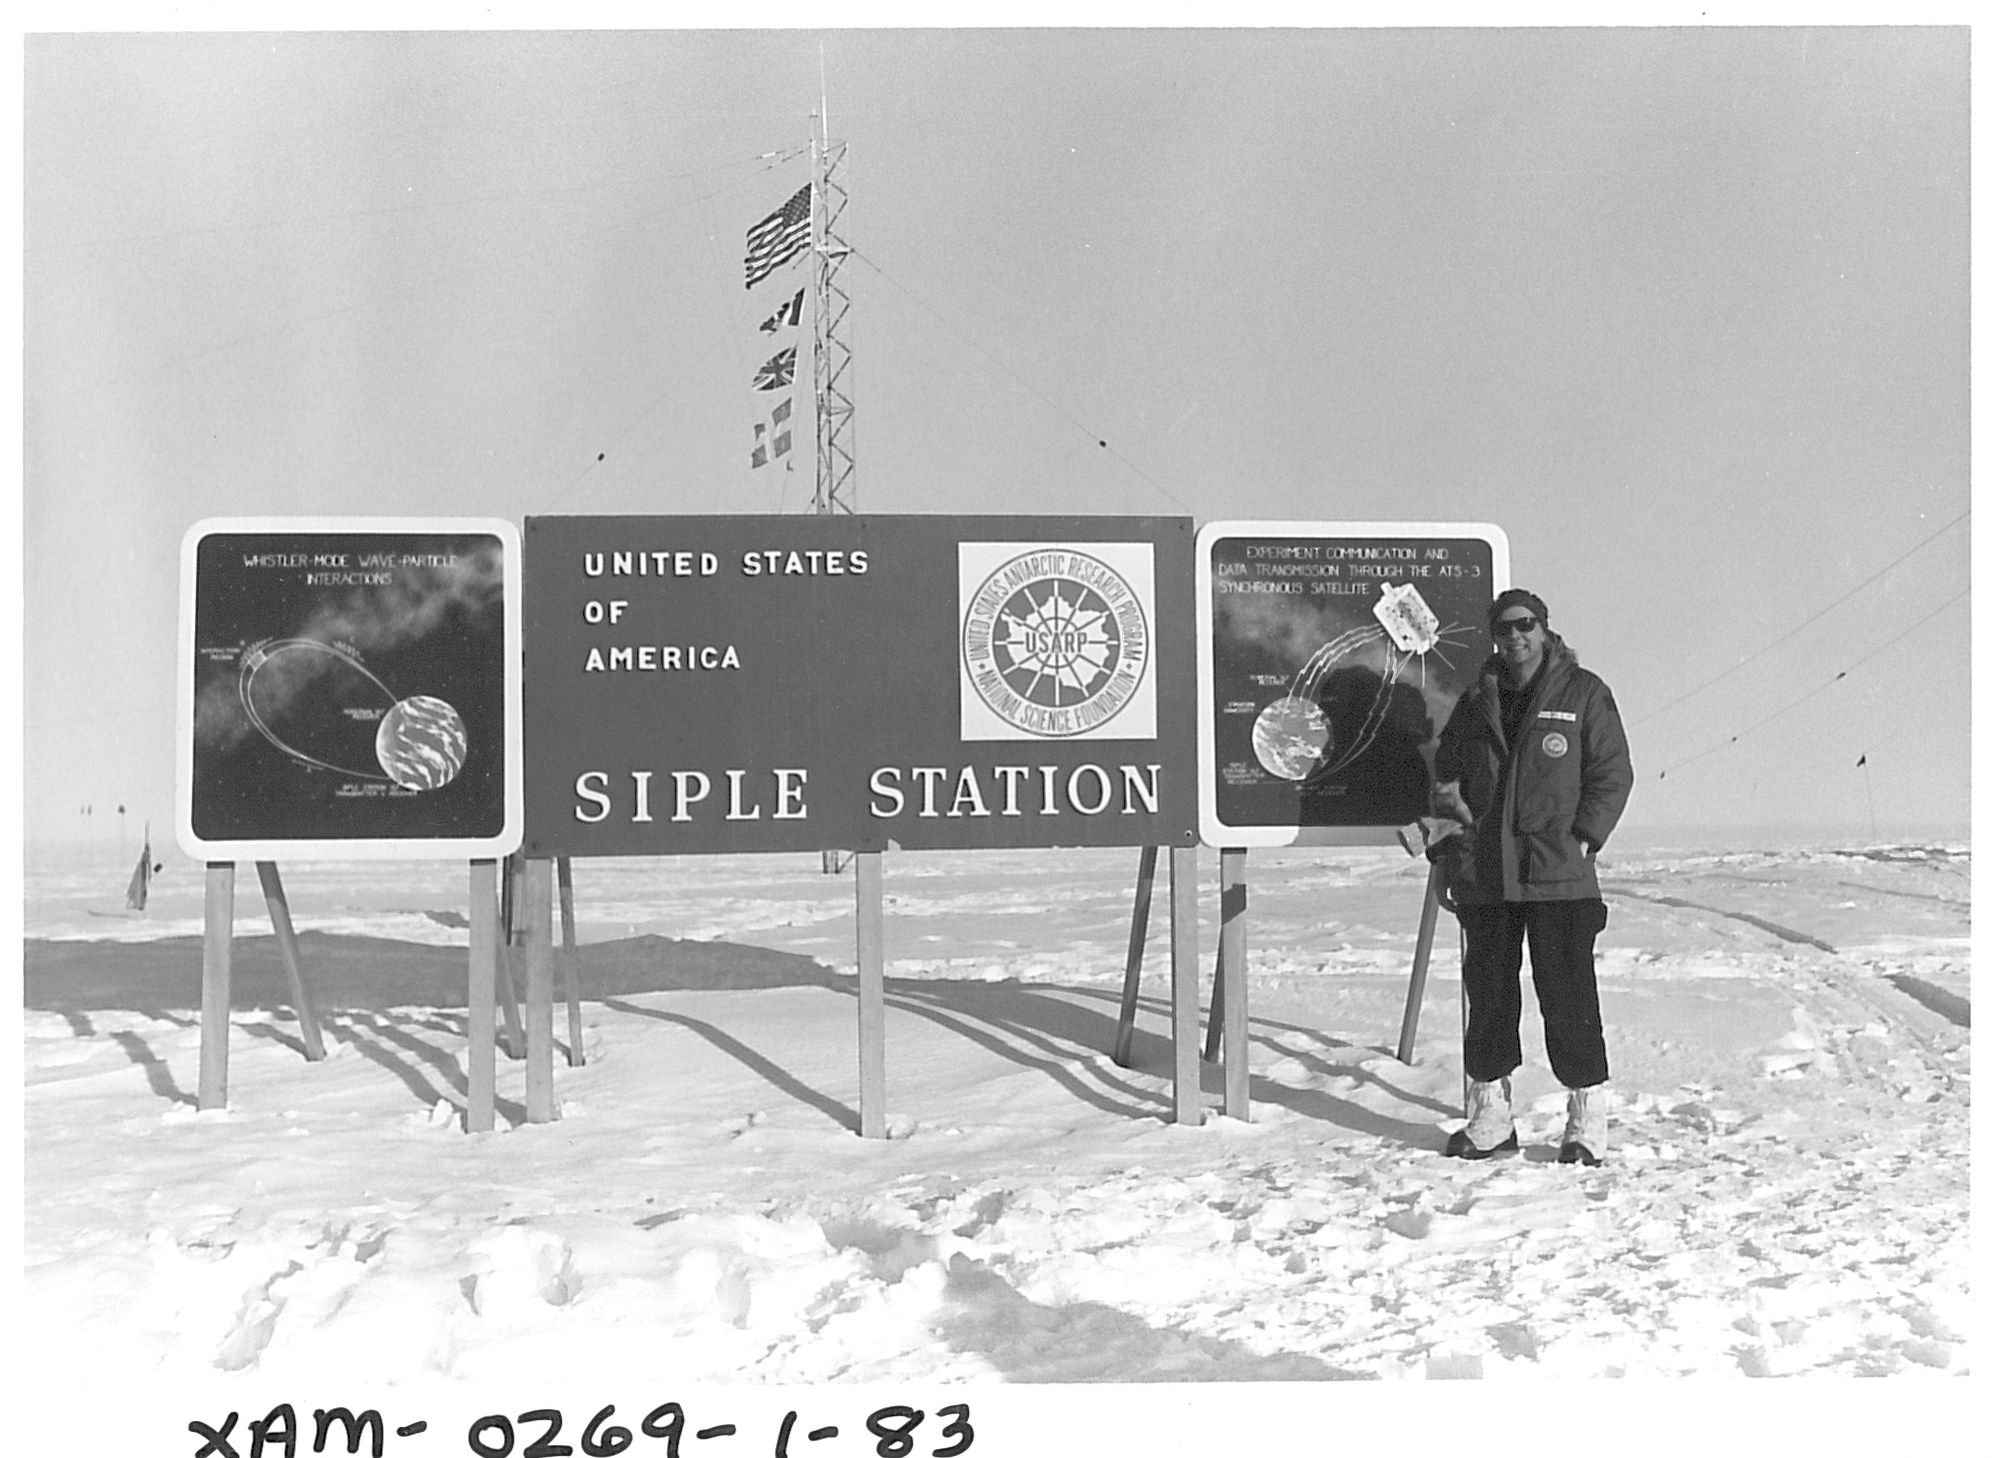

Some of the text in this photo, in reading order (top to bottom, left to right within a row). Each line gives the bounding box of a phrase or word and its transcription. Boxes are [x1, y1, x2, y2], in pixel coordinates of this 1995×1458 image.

[243, 554, 458, 568] WHISTLER-MODE WAVE-PARTICLE
[584, 551, 868, 576] UNITED STATES
[1247, 547, 1449, 559] EXPERIMENT COMMUNICATION AND
[307, 572, 392, 585] INTERACTIONS
[1218, 563, 1247, 577] DATA
[1255, 563, 1340, 577] TRANSMISSION
[1349, 563, 1403, 577] THROUGH
[1408, 563, 1431, 577] THE
[1218, 581, 1370, 595] SYNCHRONOUS SATELLITE
[584, 601, 628, 624] OF
[968, 554, 1144, 661] UNITED STATES ANTARCTIC RESEARCH PROGRAM
[1025, 631, 1088, 654] USARP
[585, 646, 740, 671] AMERICA
[976, 668, 1137, 732] NATIONAL SCIENCE FOUNDATION
[575, 764, 1162, 822] SIPLE STATION
